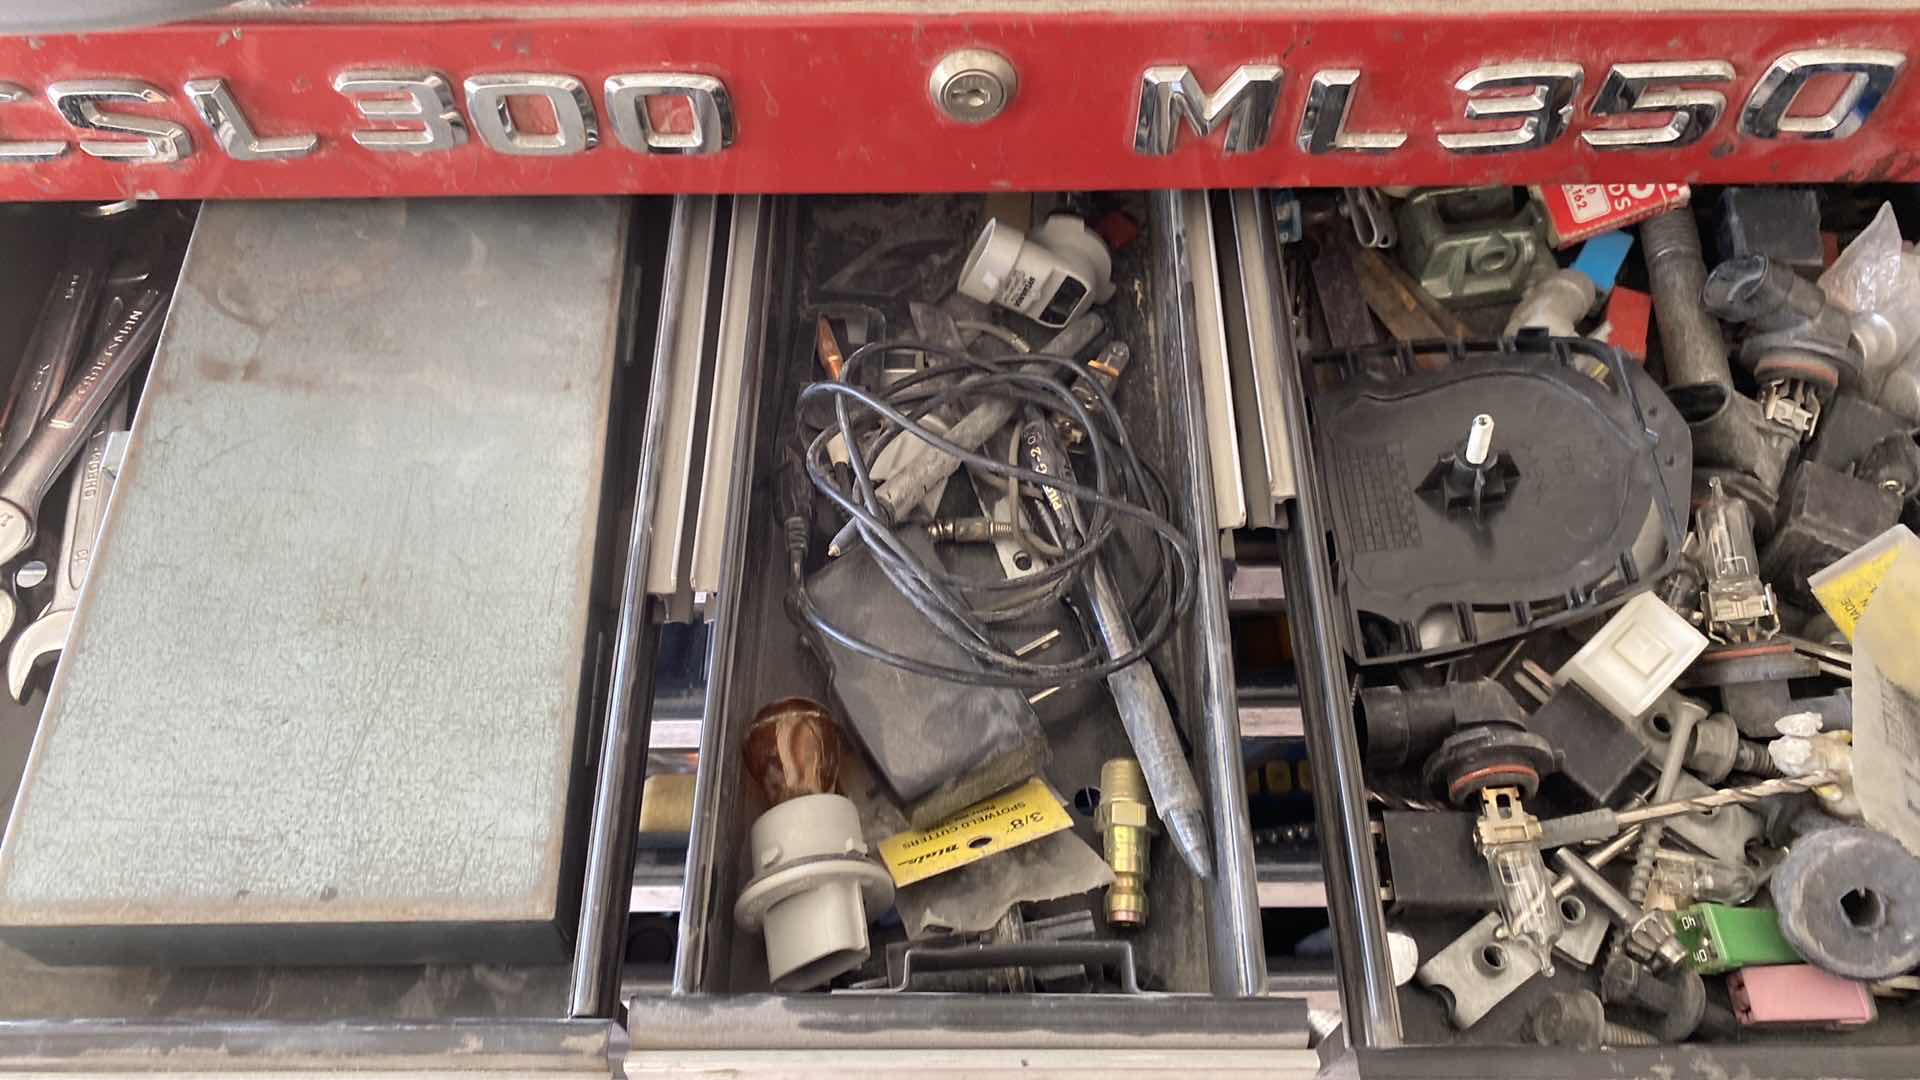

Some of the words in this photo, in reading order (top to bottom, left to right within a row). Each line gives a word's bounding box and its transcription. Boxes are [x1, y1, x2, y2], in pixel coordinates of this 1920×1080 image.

[334, 66, 737, 155] 300
[1132, 65, 1408, 155] ML
[1437, 48, 1907, 153] 350
